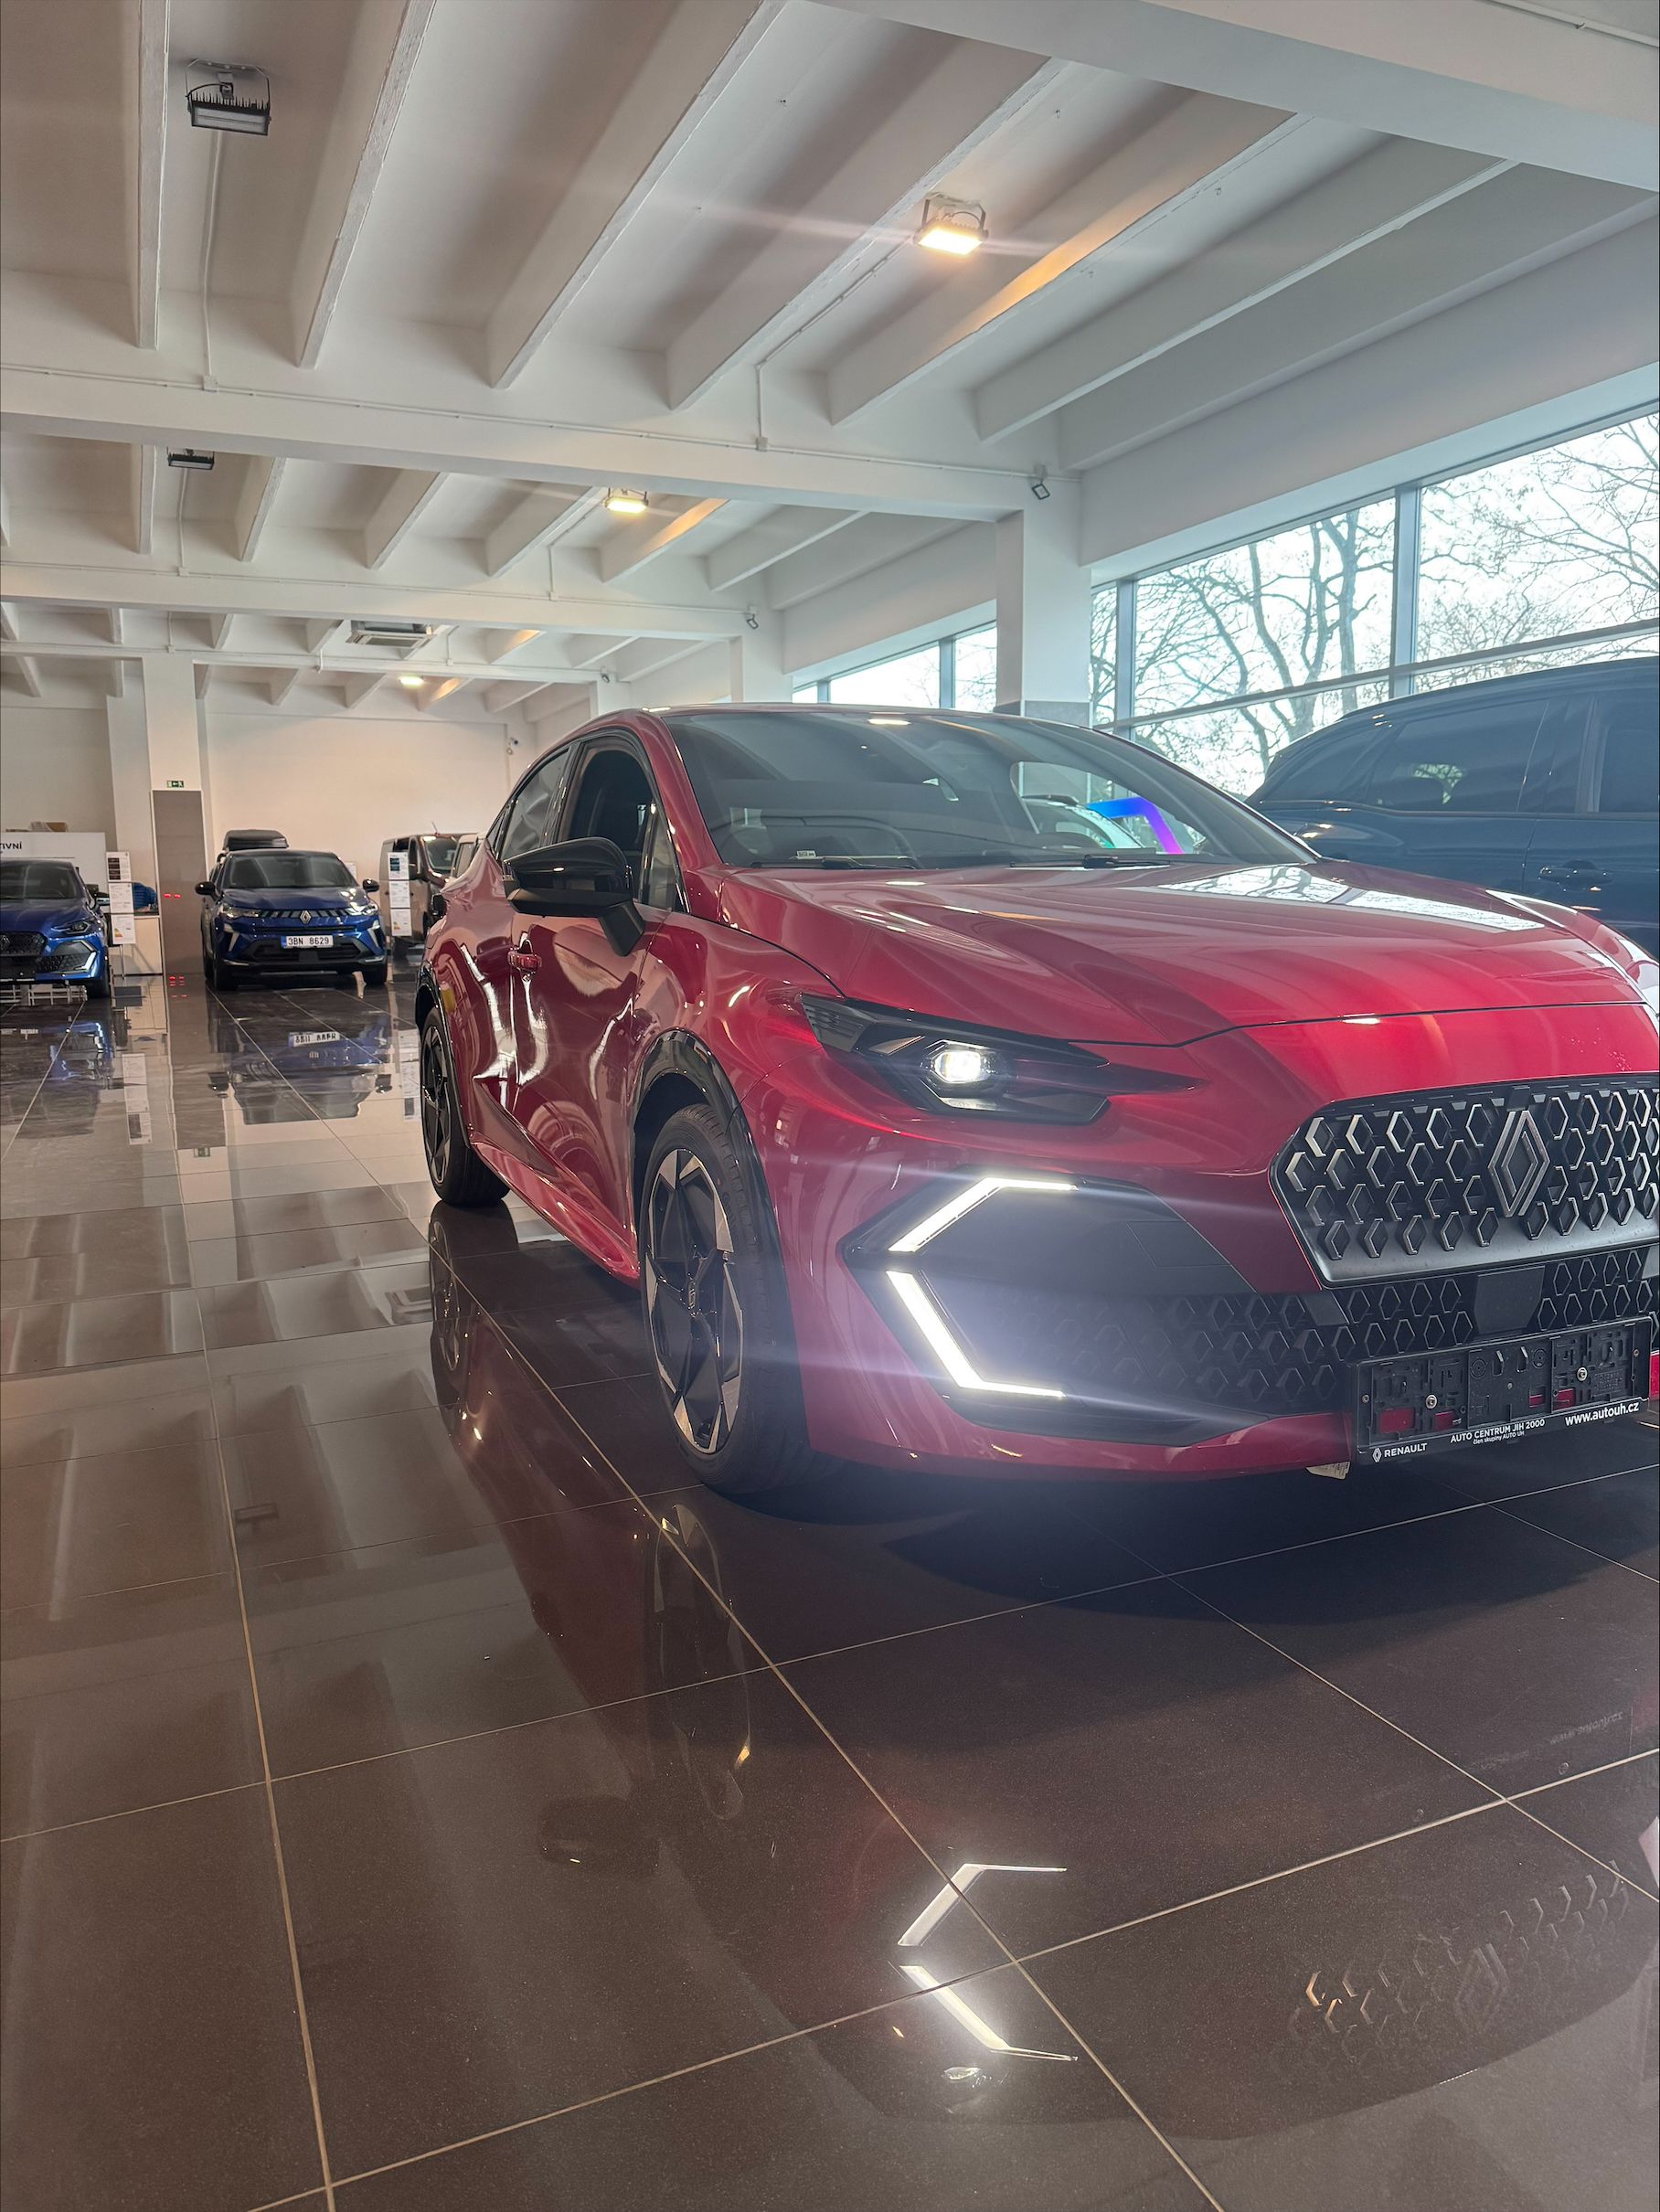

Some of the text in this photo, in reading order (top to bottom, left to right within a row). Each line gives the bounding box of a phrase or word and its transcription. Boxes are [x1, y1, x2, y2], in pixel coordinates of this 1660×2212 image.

[1, 841, 22, 849] IVNÍ
[288, 937, 329, 945] 3BN 8629
[1565, 1402, 1639, 1426] www.autouh.cz
[1450, 1419, 1546, 1443] AUTO CENTRUM JIH 2000
[1502, 1431, 1516, 1440] AUTO
[1384, 1443, 1428, 1458] RENAULT
